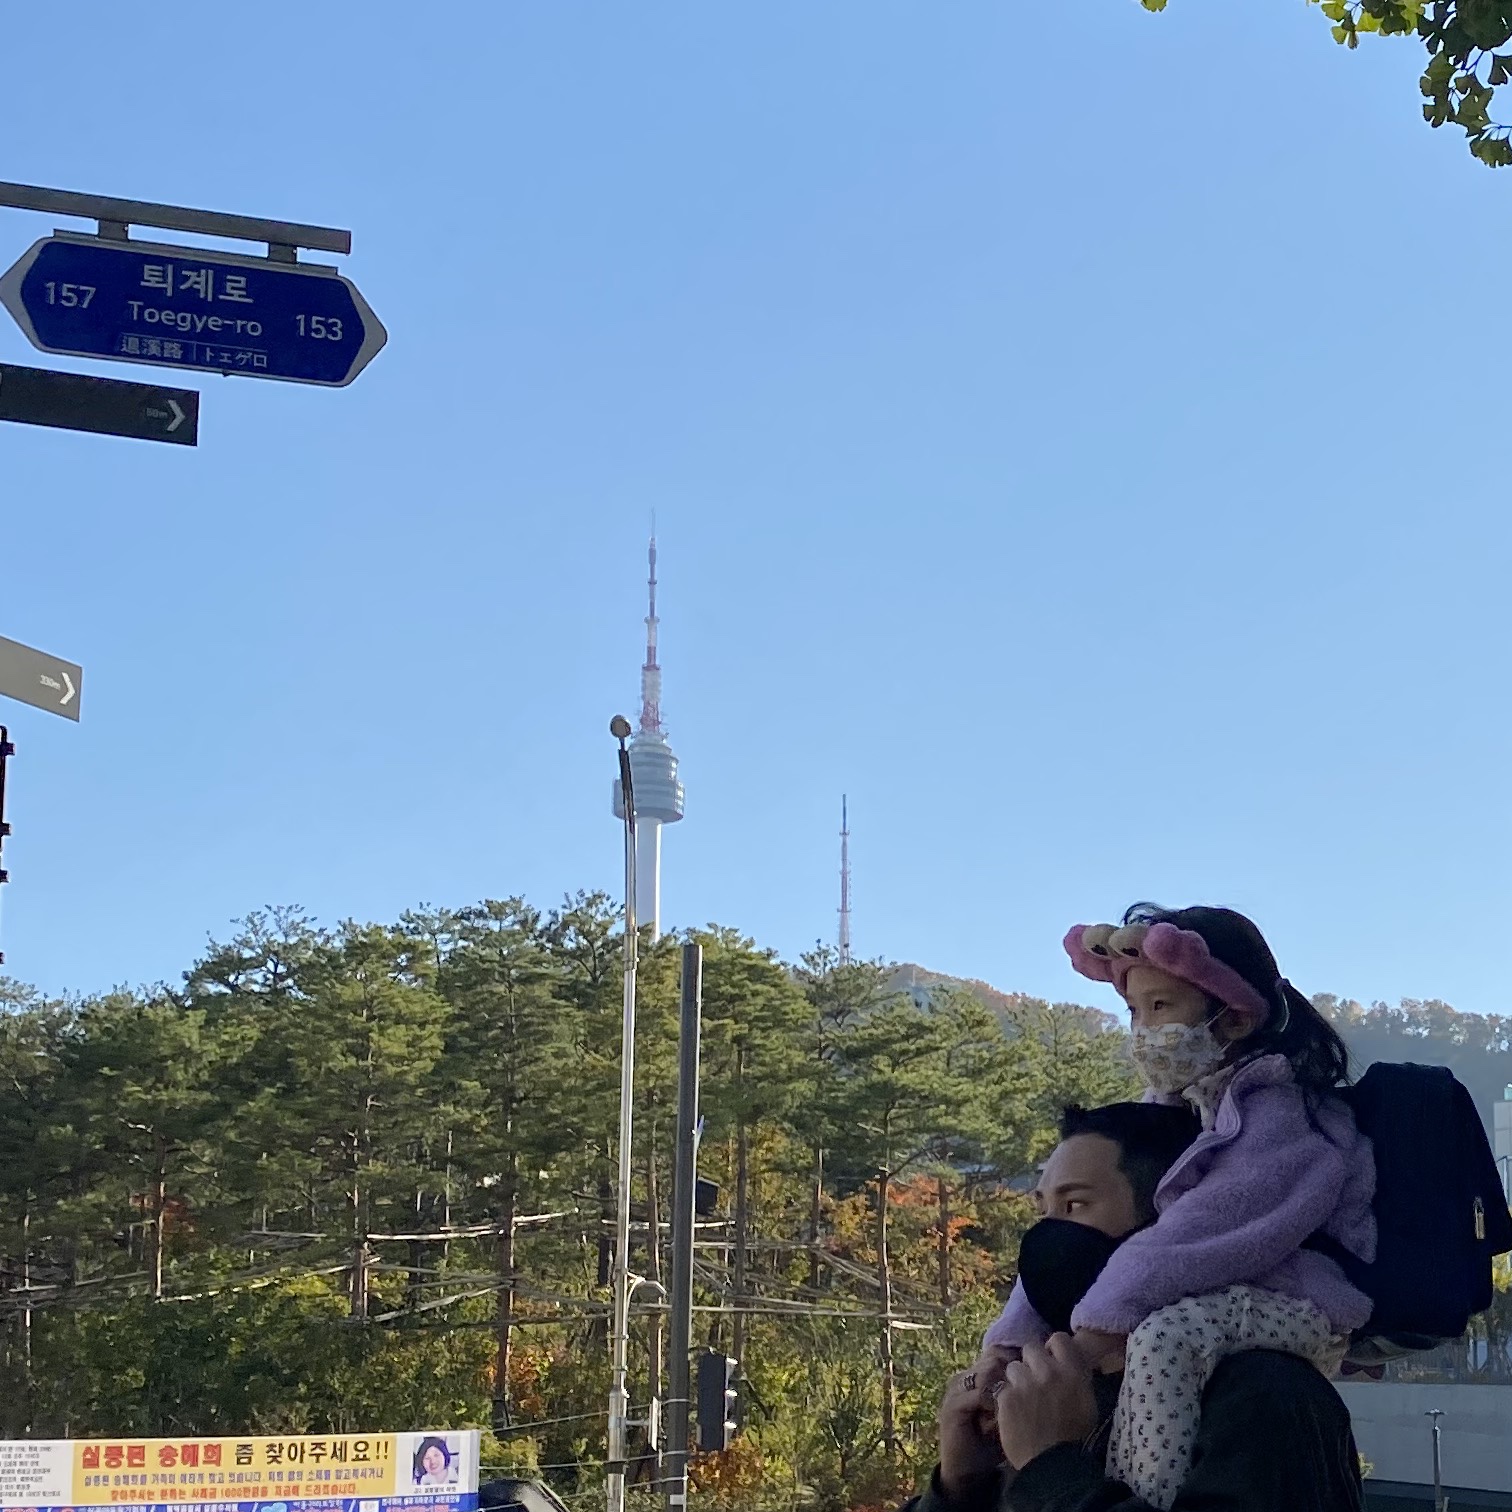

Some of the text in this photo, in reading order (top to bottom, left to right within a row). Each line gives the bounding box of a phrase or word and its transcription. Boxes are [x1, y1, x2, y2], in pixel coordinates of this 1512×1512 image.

[45, 281, 97, 309] 157
[140, 264, 254, 303] 퇴계로
[128, 300, 262, 336] Toegye-ro
[295, 313, 344, 341] 153
[82, 1445, 146, 1469] 실종된
[158, 1443, 222, 1468] 송혜희
[265, 1440, 389, 1465] 찾아주세요!!
